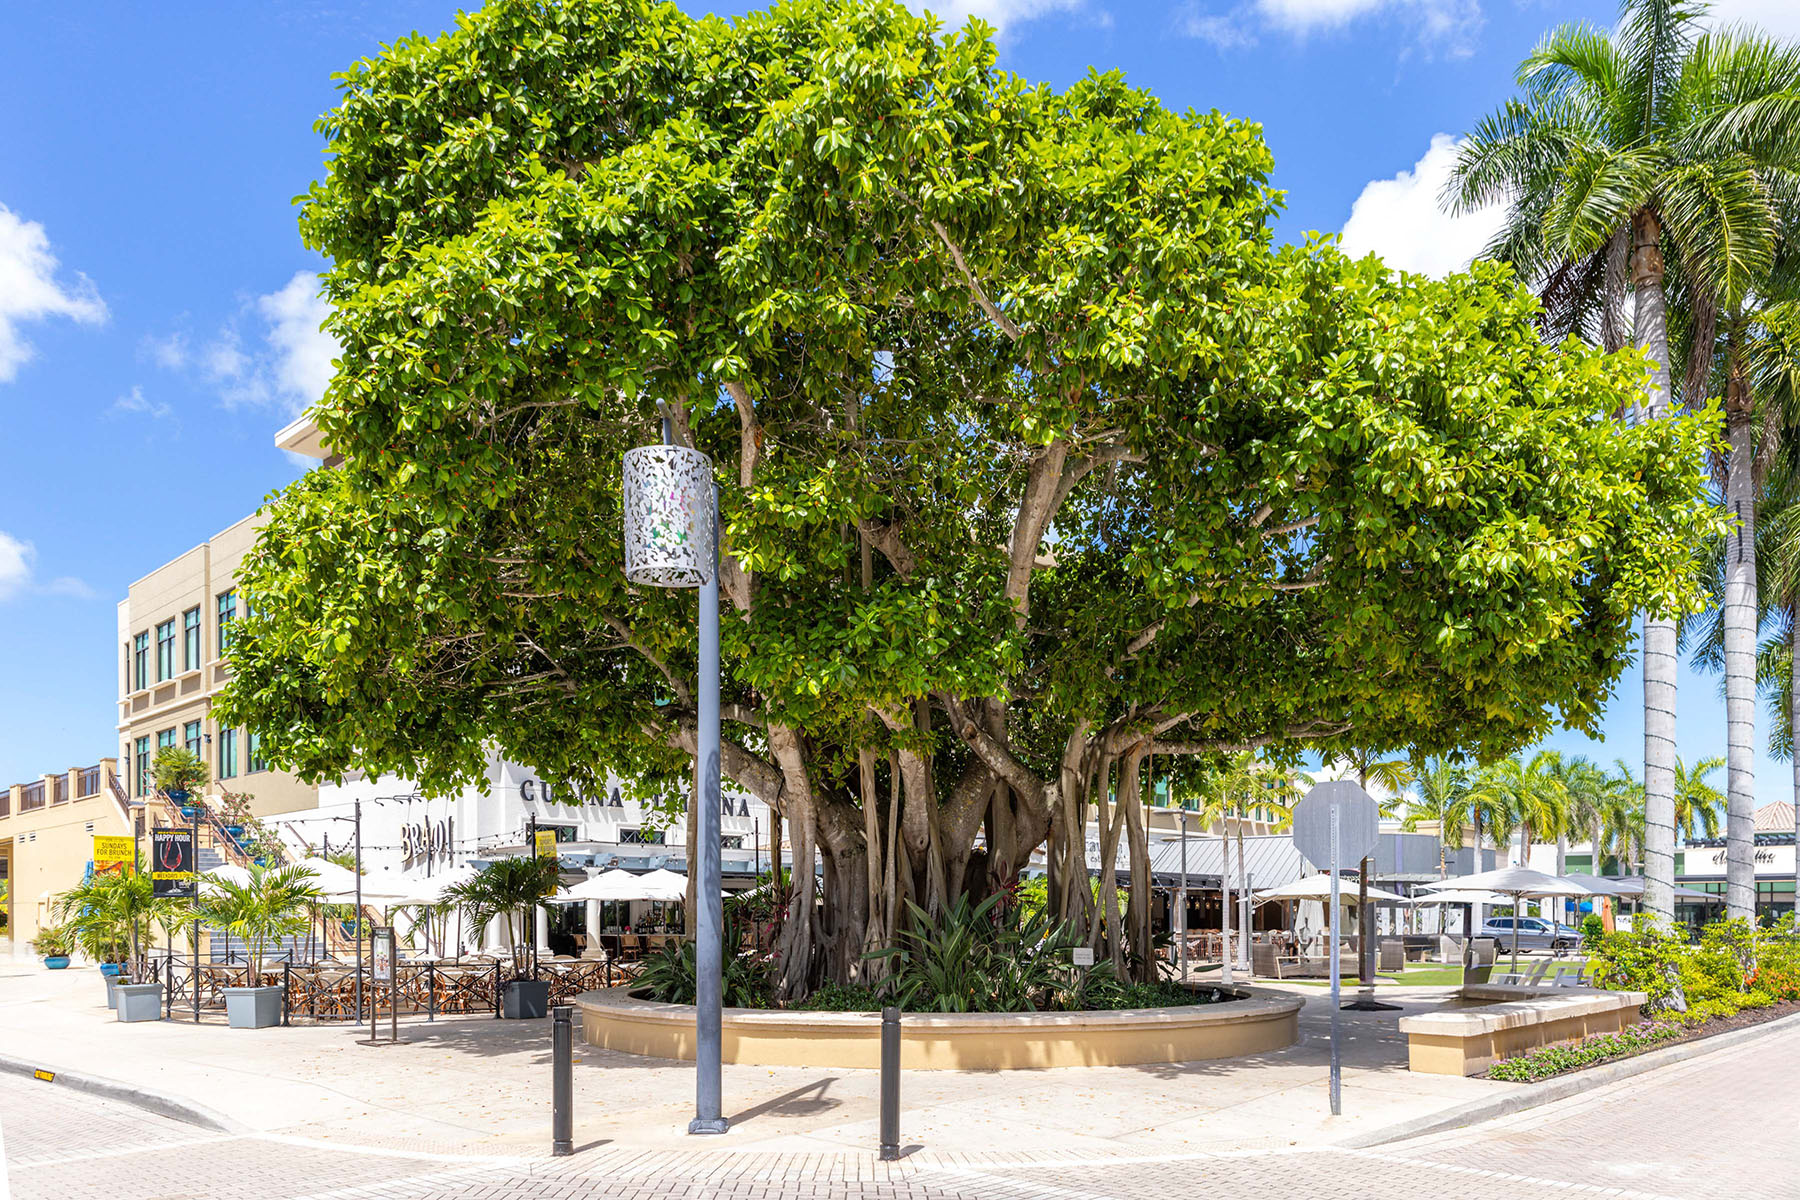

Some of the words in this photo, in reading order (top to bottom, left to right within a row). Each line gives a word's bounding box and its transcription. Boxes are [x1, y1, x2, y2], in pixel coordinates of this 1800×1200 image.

[520, 779, 624, 808] CUINA
[154, 833, 174, 842] HAPPY
[174, 834, 191, 842] HOUR
[101, 842, 127, 850] SUNDAYS
[96, 848, 108, 856] FOR
[108, 849, 132, 857] BRUNCH
